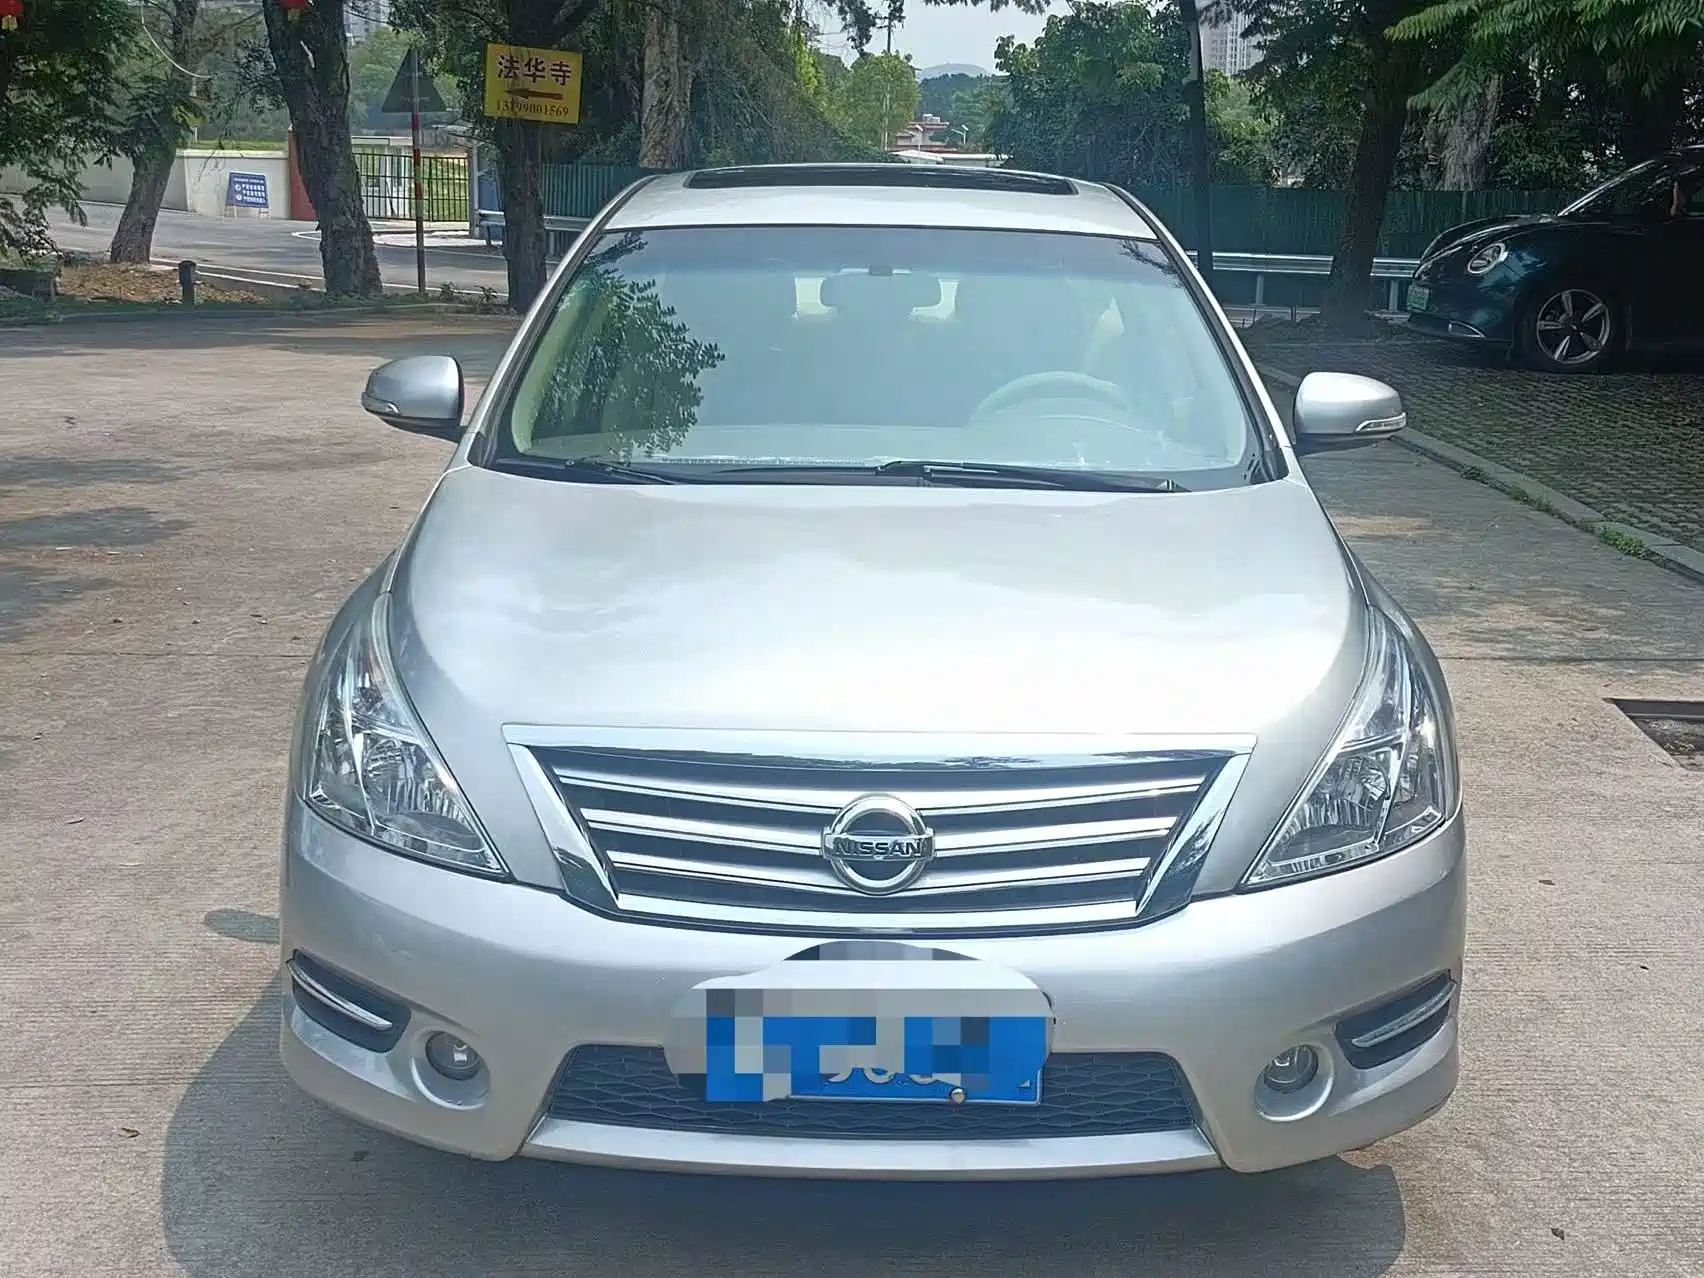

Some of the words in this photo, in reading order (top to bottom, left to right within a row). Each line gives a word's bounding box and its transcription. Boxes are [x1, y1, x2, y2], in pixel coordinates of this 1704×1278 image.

[497, 53, 572, 86] 法华寺
[833, 837, 921, 856] NISSAN
